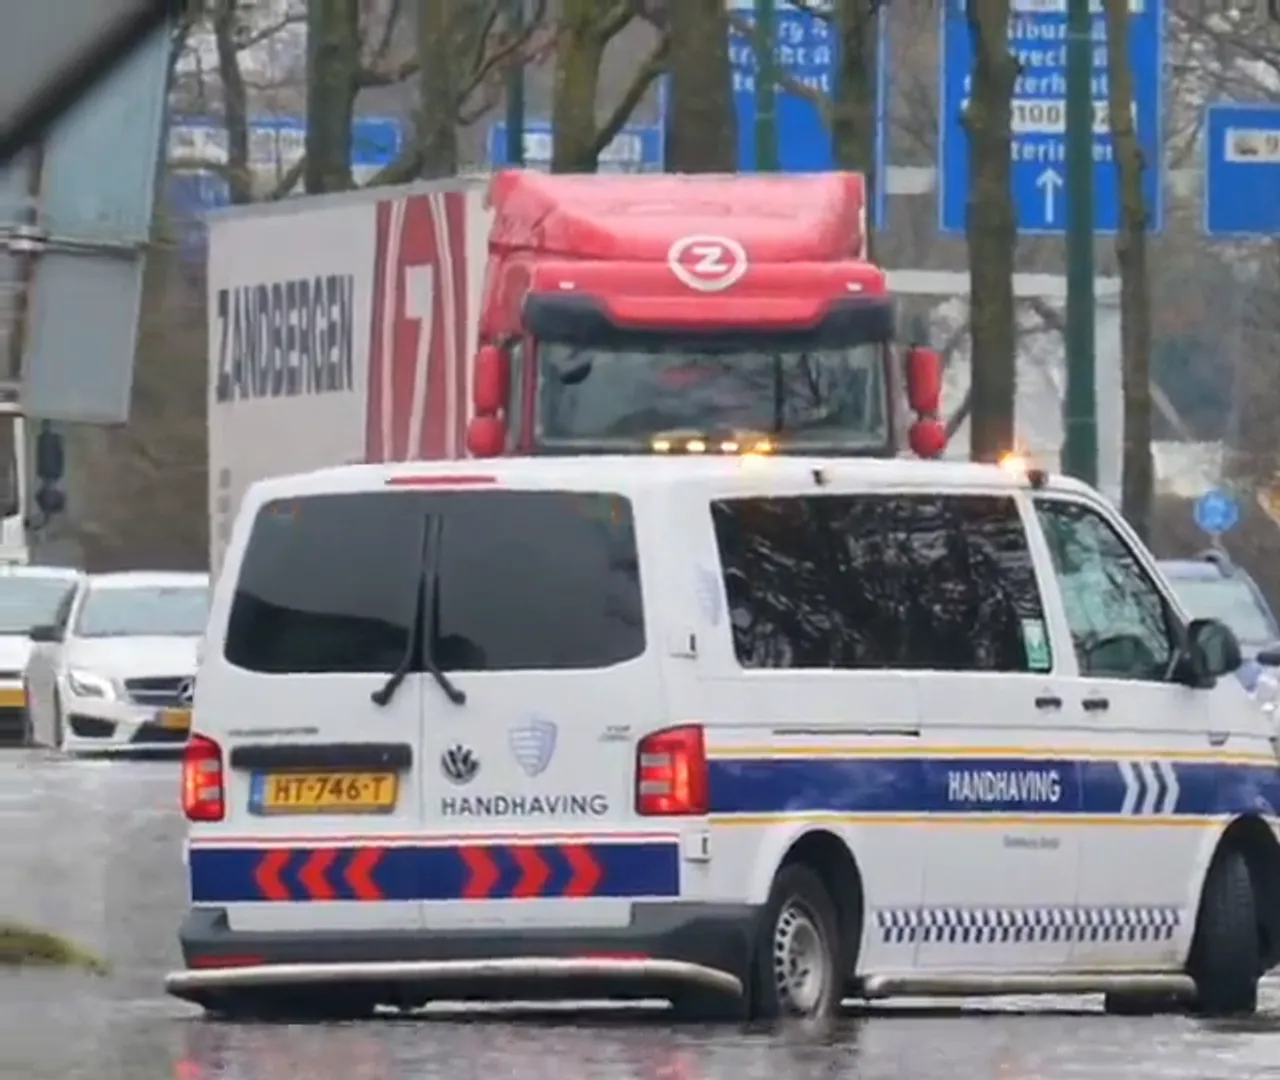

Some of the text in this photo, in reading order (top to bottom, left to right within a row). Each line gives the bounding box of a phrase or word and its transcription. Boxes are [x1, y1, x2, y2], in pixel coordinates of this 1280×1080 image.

[217, 274, 354, 404] ZANDBERGEN
[948, 769, 1062, 803] HANDHAVING
[441, 794, 609, 816] HANDHAVING
